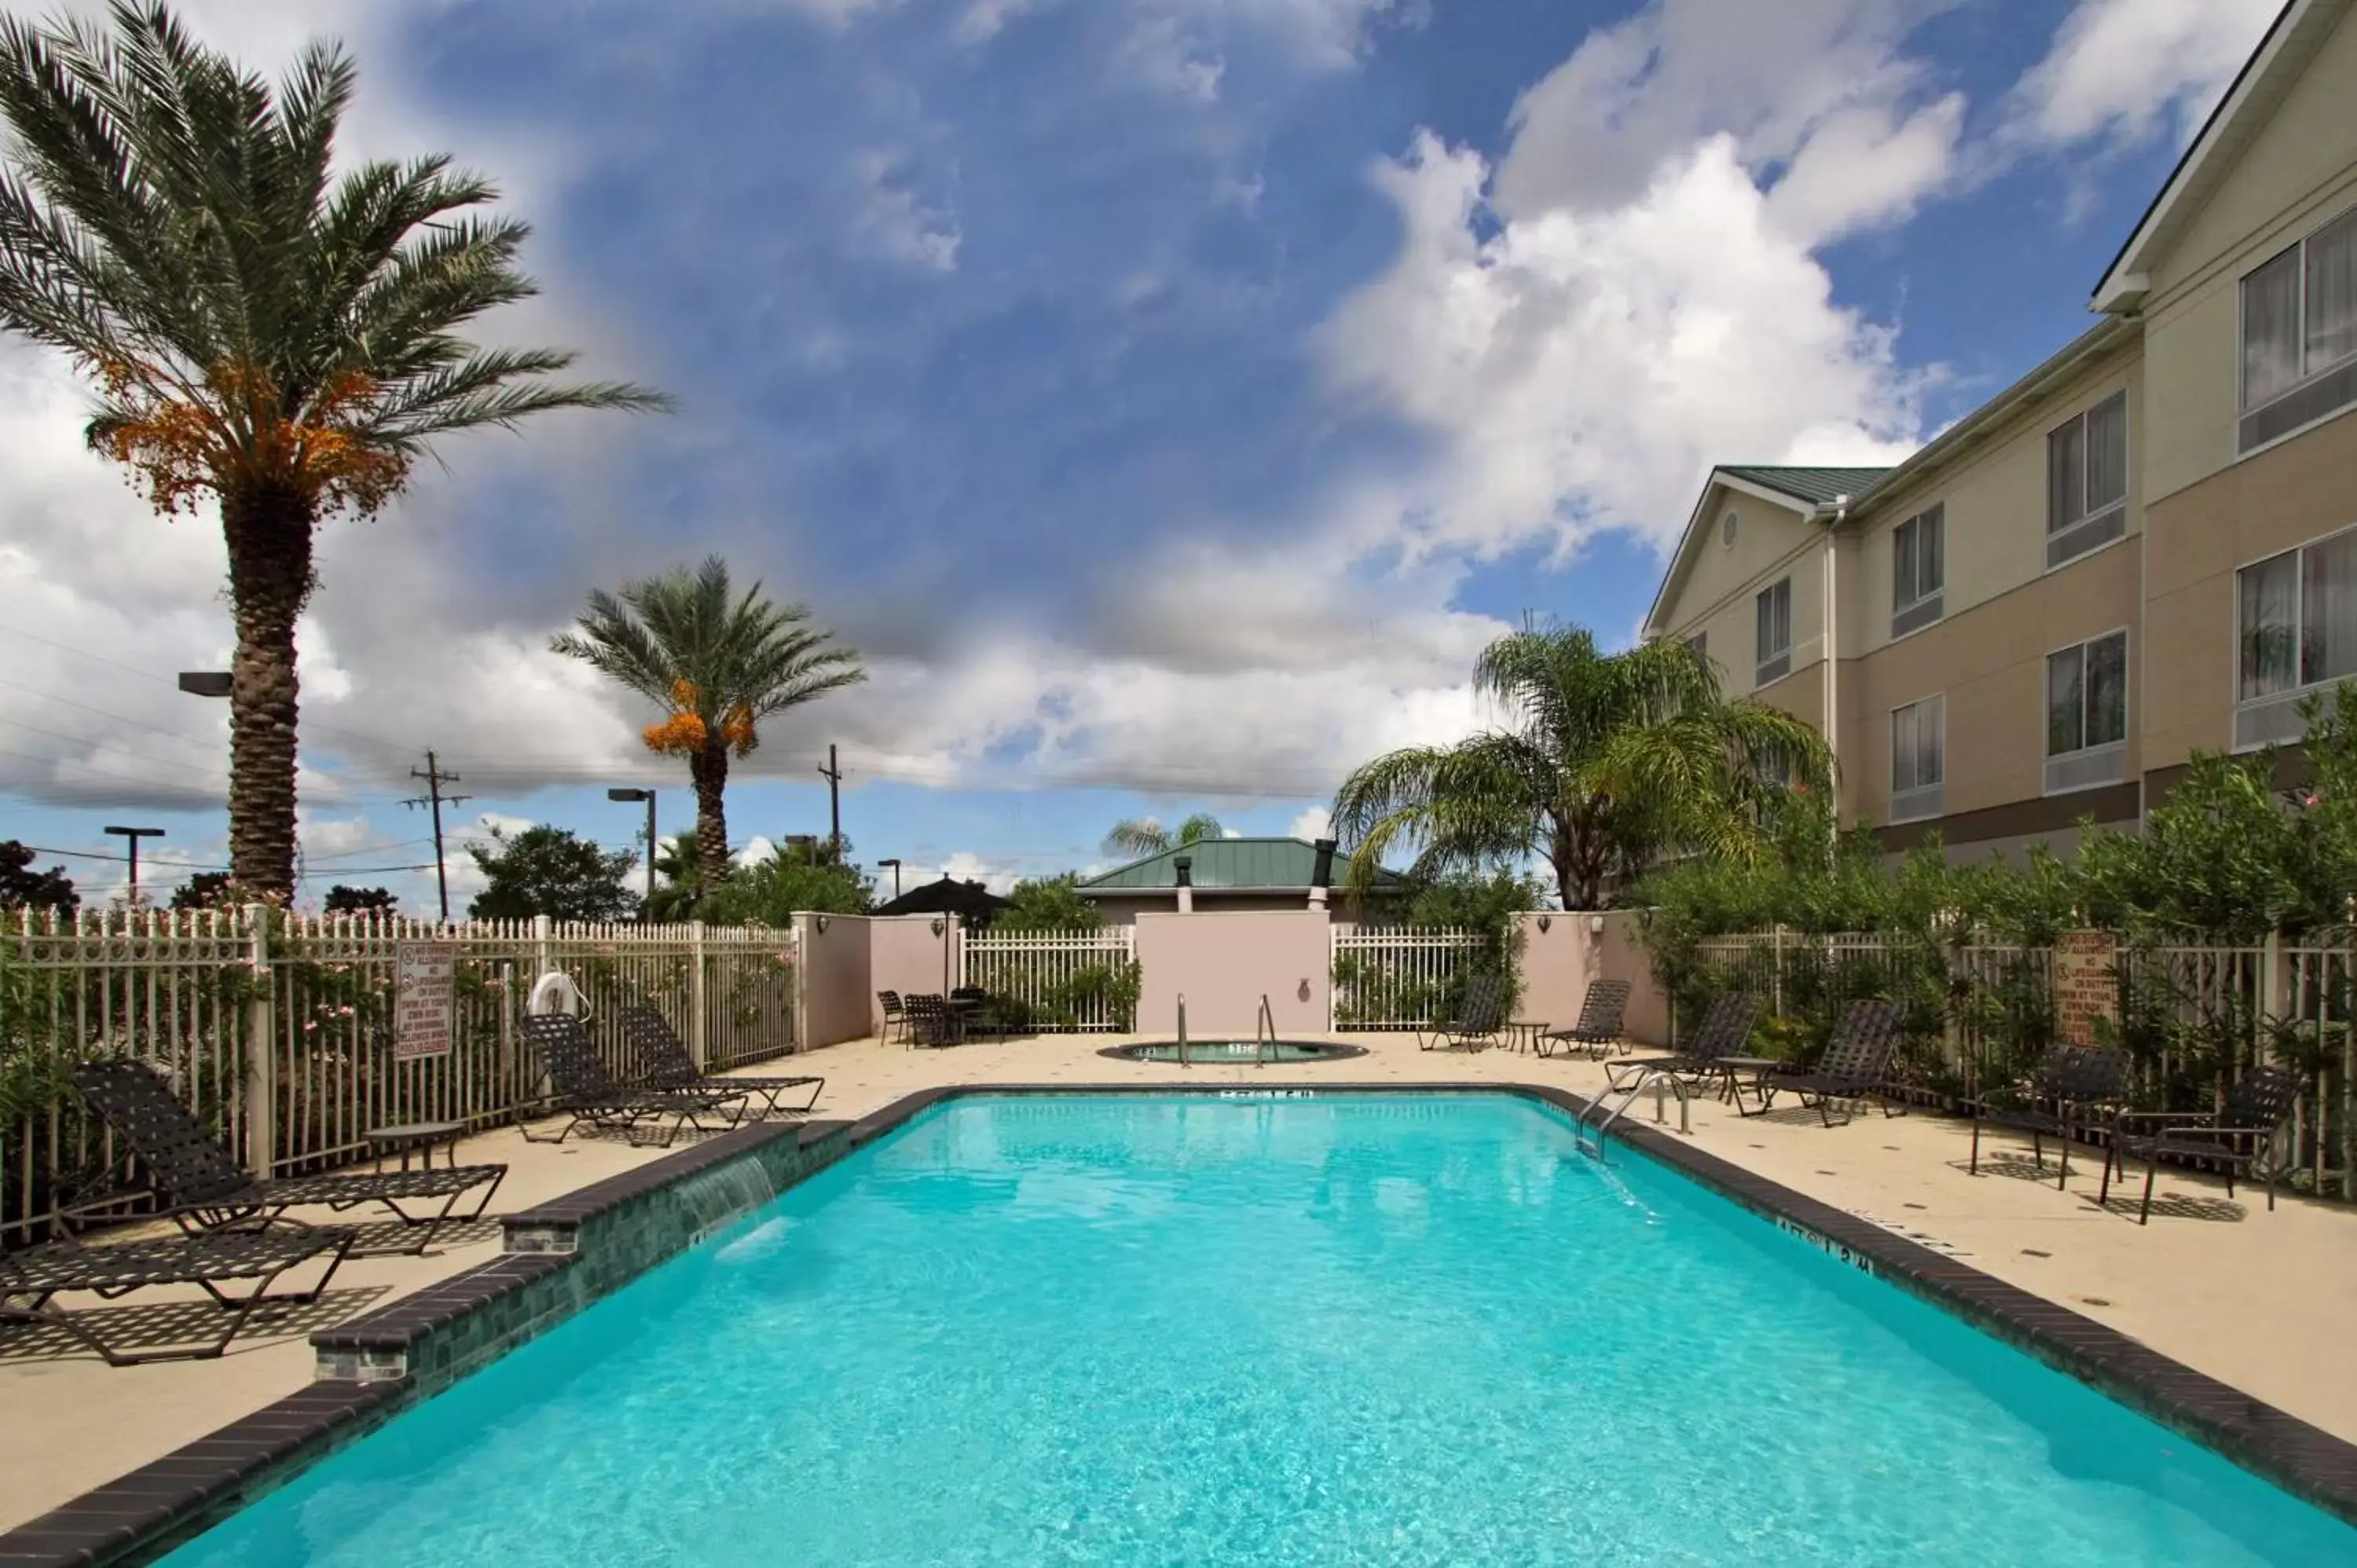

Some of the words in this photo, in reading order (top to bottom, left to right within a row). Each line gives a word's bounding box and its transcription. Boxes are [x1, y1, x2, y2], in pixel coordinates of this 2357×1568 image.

[416, 946, 426, 955] NO
[2085, 957, 2096, 967] NO
[2079, 991, 2088, 1000] AT
[2090, 991, 2111, 1002] YOUR
